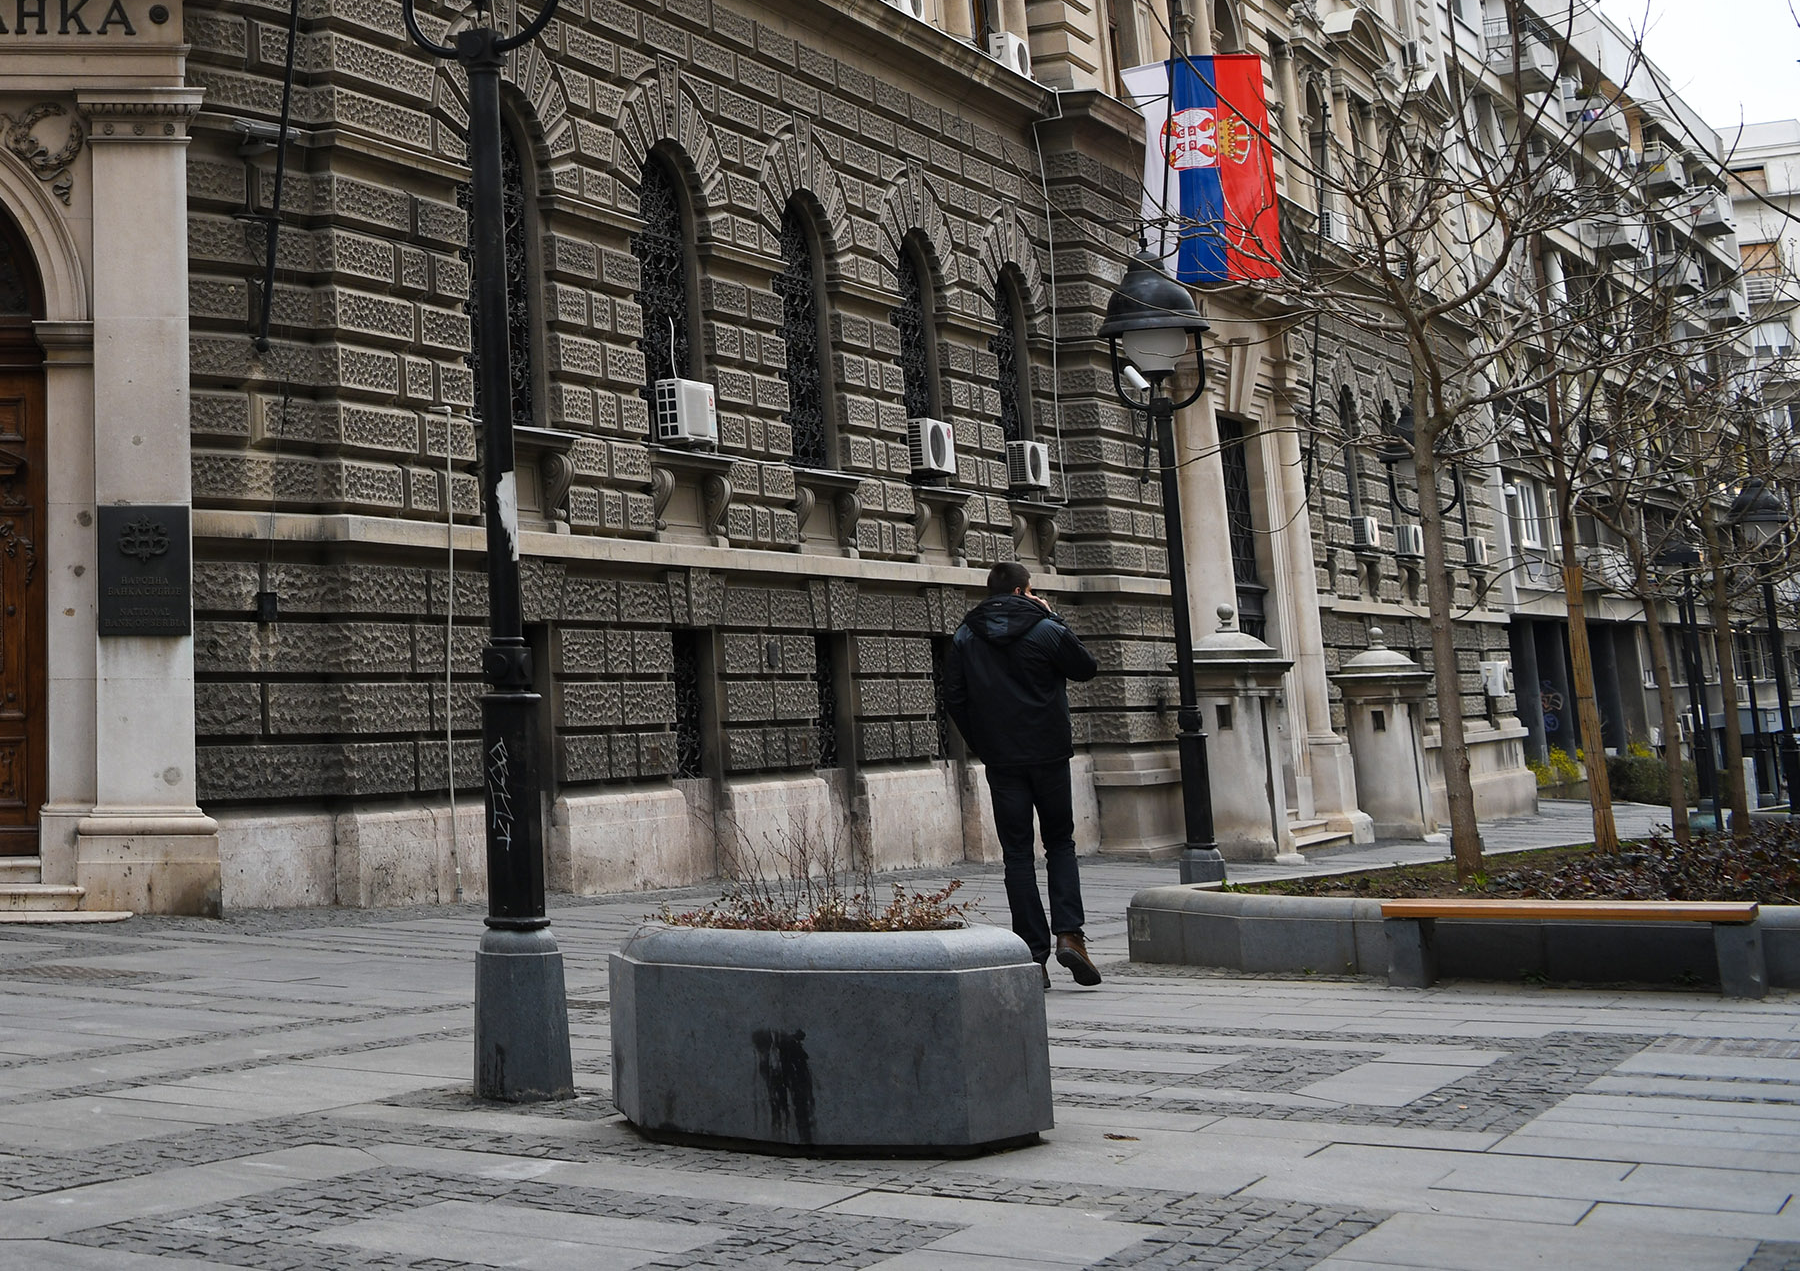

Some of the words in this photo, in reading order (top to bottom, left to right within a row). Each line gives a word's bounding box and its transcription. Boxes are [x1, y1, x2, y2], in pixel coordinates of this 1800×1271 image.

[121, 576, 169, 585] НАРОДНА
[108, 587, 142, 595] БАНКА
[145, 587, 182, 595] СРБИЈЕ
[119, 608, 171, 617] NATIONAL
[104, 618, 133, 627] BANK
[135, 618, 148, 627] OF
[150, 618, 187, 627] SERBIA
